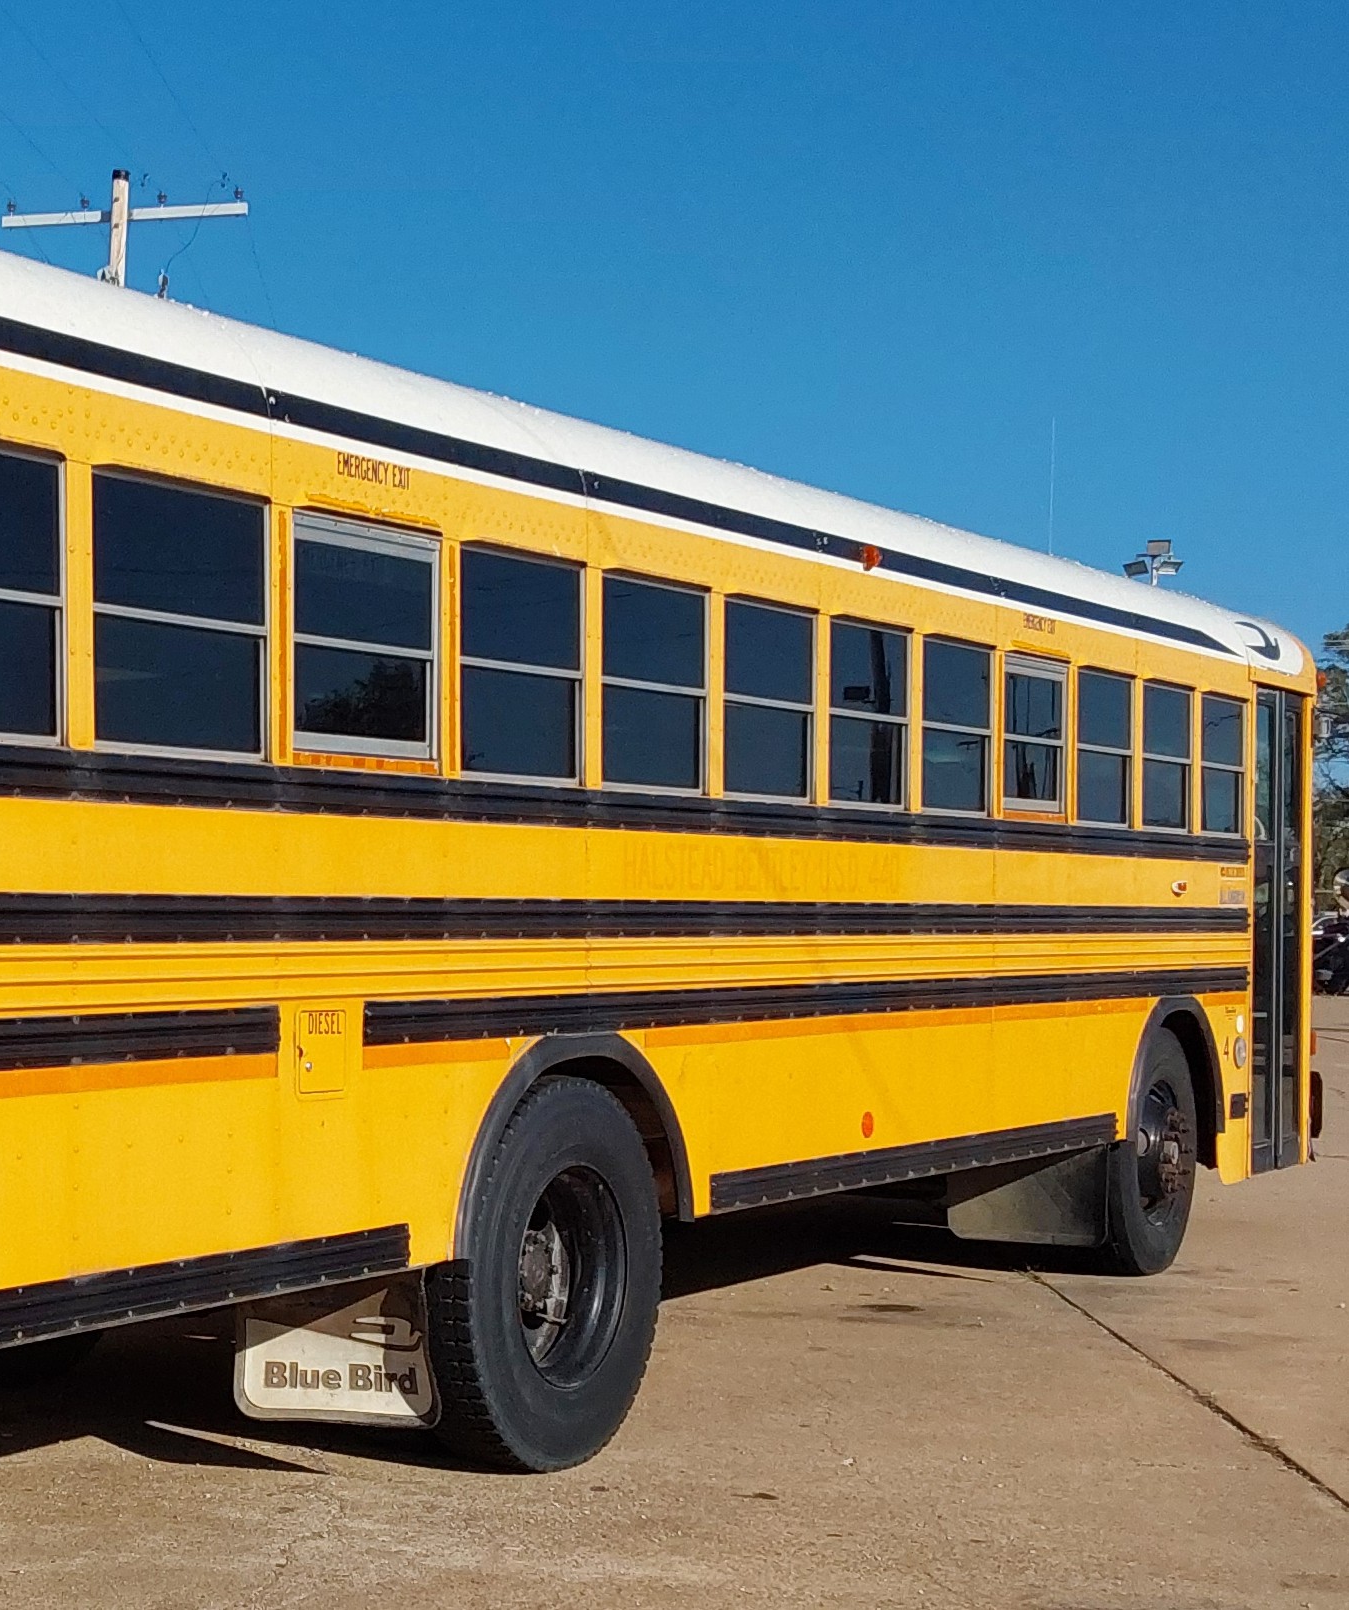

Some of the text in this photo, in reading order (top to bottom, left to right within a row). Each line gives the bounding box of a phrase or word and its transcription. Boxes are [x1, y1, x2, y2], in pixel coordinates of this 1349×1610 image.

[337, 451, 411, 491] EMERGENCY EXIT
[308, 1011, 342, 1035] DIESEL
[1223, 1036, 1229, 1061] 4
[263, 1361, 418, 1396] Blue Bird
